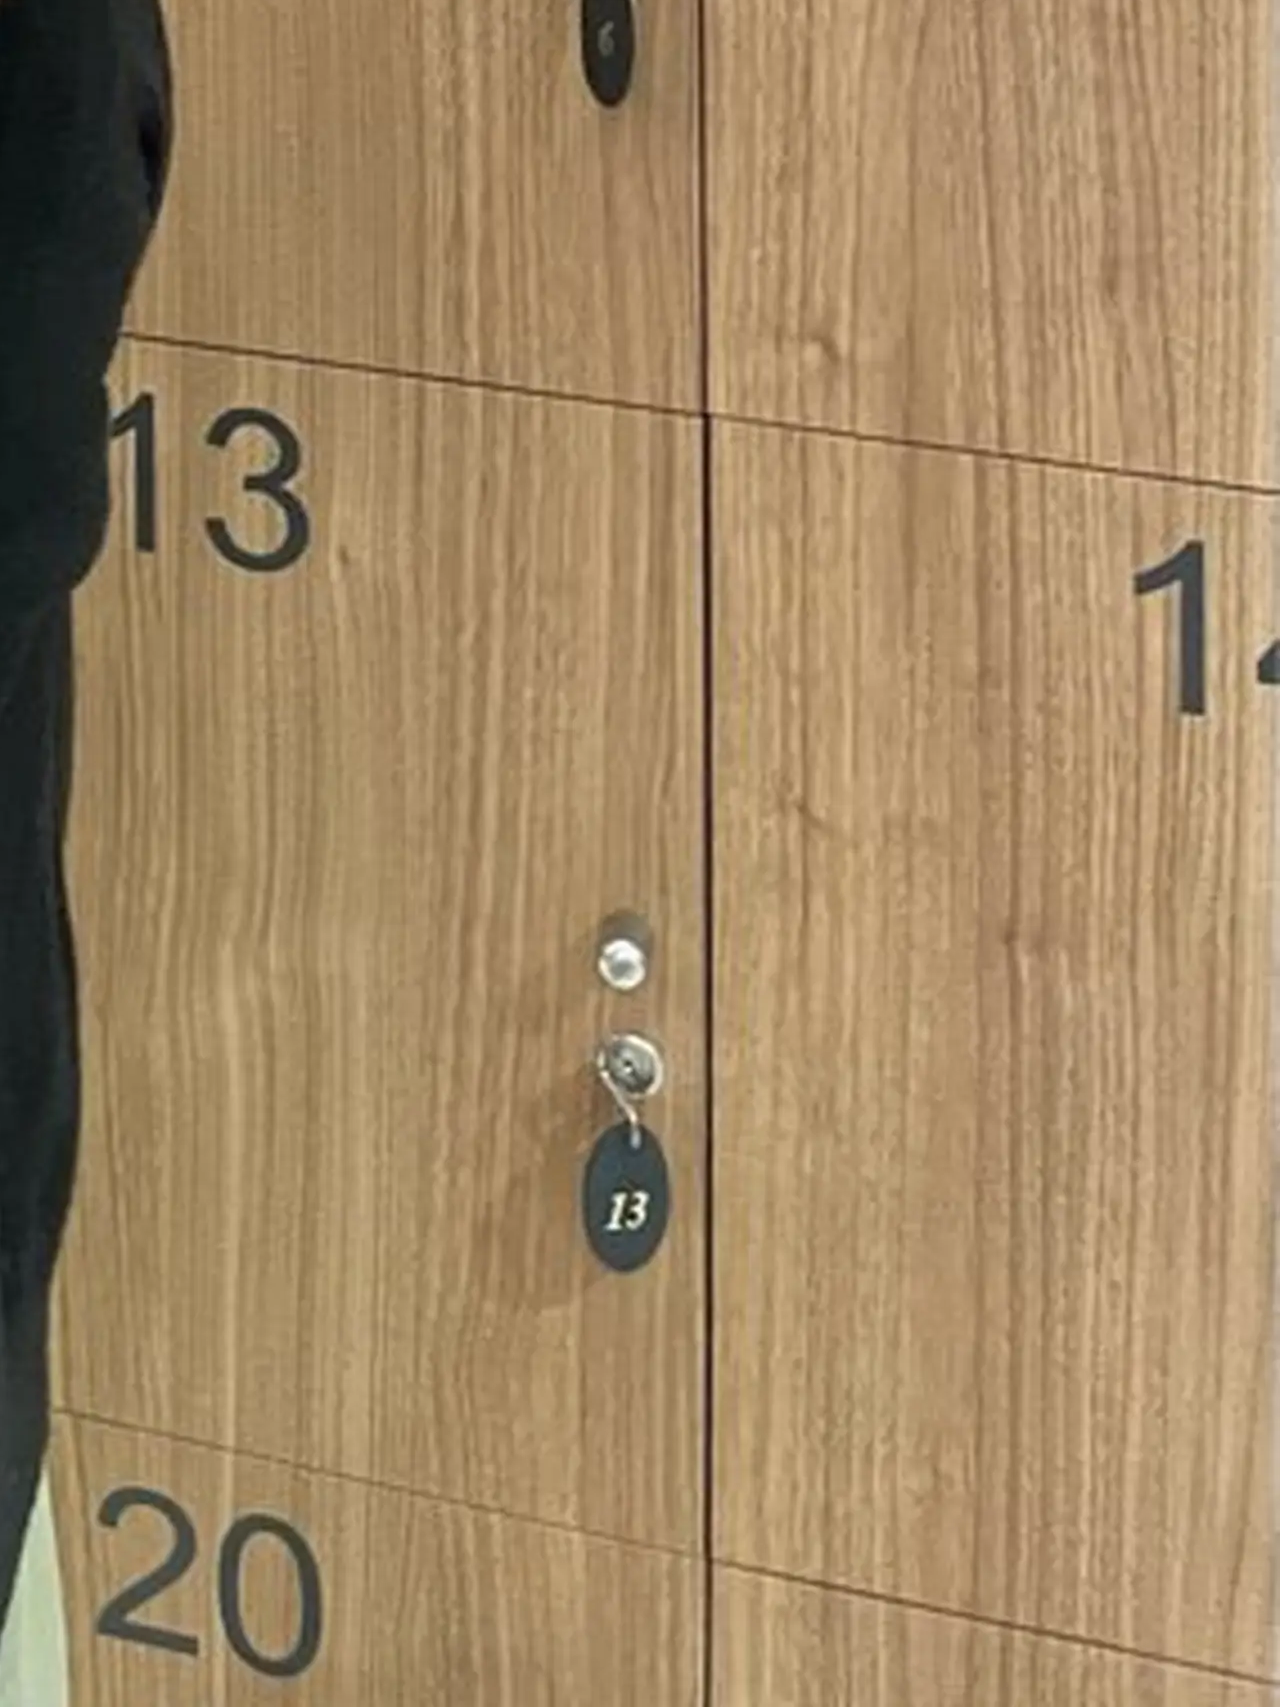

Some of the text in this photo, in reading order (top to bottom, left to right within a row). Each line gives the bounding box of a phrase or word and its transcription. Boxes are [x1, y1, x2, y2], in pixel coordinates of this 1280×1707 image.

[109, 391, 309, 573] 13
[1133, 540, 1280, 715] 1
[605, 1190, 651, 1232] 13
[96, 1487, 323, 1677] 20
